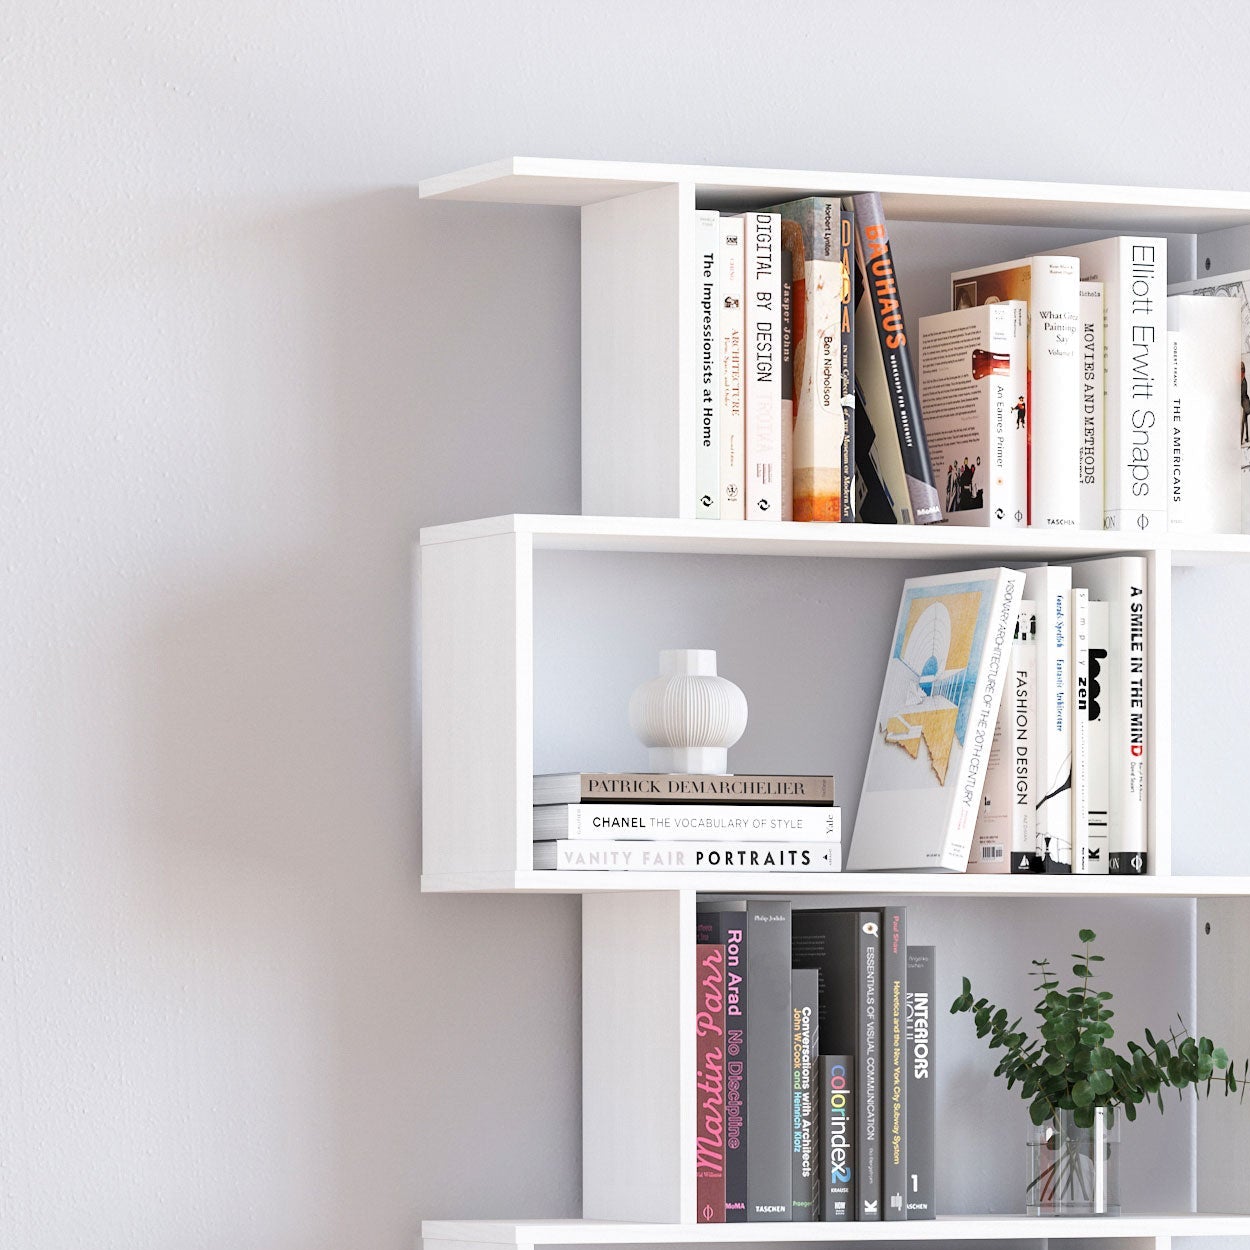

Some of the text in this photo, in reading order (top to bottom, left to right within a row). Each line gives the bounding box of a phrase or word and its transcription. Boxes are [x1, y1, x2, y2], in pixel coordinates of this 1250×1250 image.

[823, 204, 832, 256] Norbert Lynton
[757, 214, 772, 382] DIGITAL BY DESIGN
[782, 283, 791, 362] Jasper Johns
[865, 224, 906, 349] BAUHAUS
[702, 253, 714, 446] The Impressionists at Home
[823, 337, 832, 406] Ben Nicholson
[997, 386, 1004, 399] An
[1128, 246, 1155, 496] Elliott Erwitt Snaps
[1085, 323, 1095, 484] MOVIES AND METHODS
[1173, 427, 1181, 502] AMERICANS
[1078, 677, 1088, 710] zen
[1131, 586, 1142, 756] A SMILE IN THE MIND
[589, 779, 805, 795] PATRICK DEMARCHELIER
[1016, 671, 1028, 805] FASHION DESIGN
[564, 851, 810, 865] VANITY FAIR PORTRAITS
[593, 817, 802, 829] CHANEL THE VOCABULARY OF STYLE
[697, 950, 722, 1037] Parr
[725, 930, 742, 1148] Ron Arad No Discipline
[866, 947, 874, 1140] ESSENTIALS OF VISUAL COMMUNICATION
[914, 993, 928, 1079] INTERIORS
[697, 1047, 722, 1173] Martin
[801, 1007, 811, 1177] Conversations with Architects
[830, 1065, 850, 1183] colorindex2
[756, 1205, 785, 1213] TASCHEN
